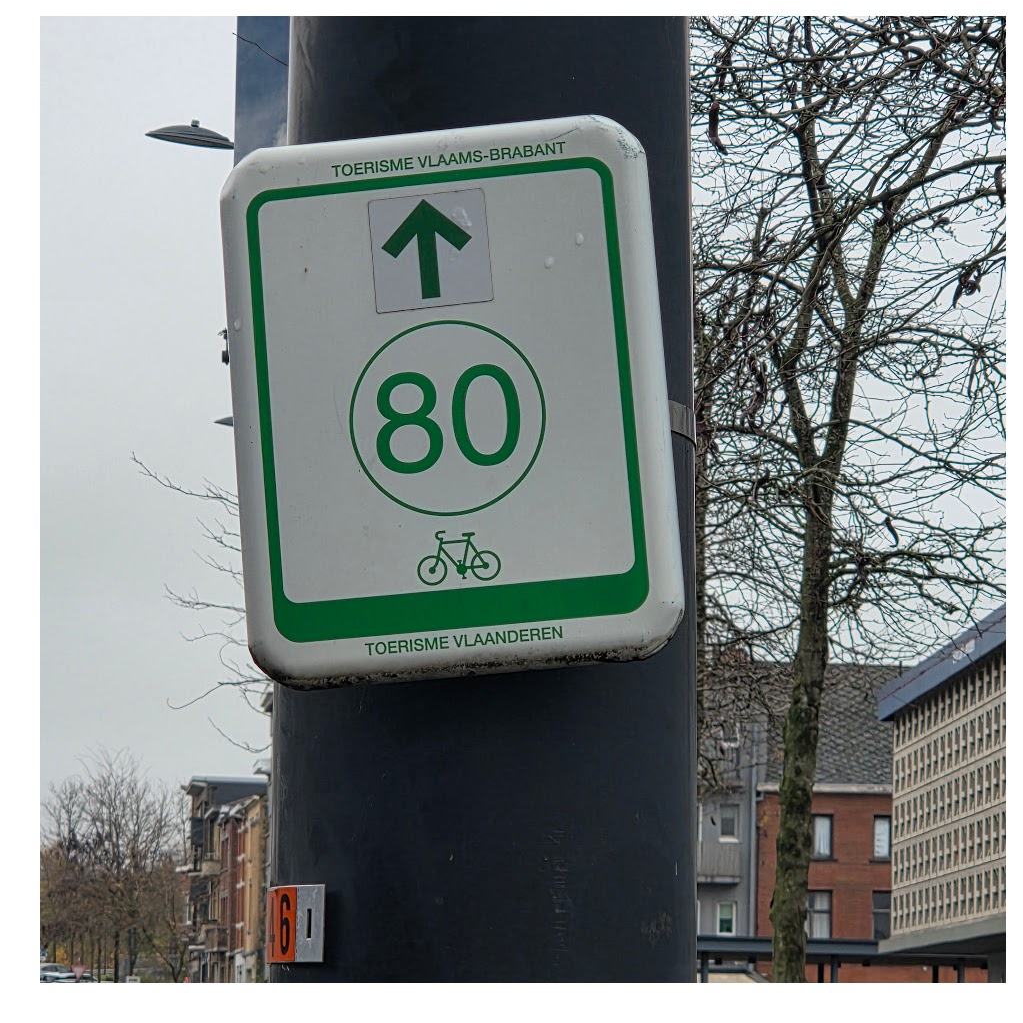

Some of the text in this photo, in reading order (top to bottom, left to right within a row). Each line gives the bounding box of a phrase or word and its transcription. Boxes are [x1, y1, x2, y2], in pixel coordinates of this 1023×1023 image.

[331, 142, 566, 178] TOERISME VLAAMS-BRABANT
[376, 363, 520, 474] 80
[364, 626, 563, 656] TOERISME VLAANDEREN
